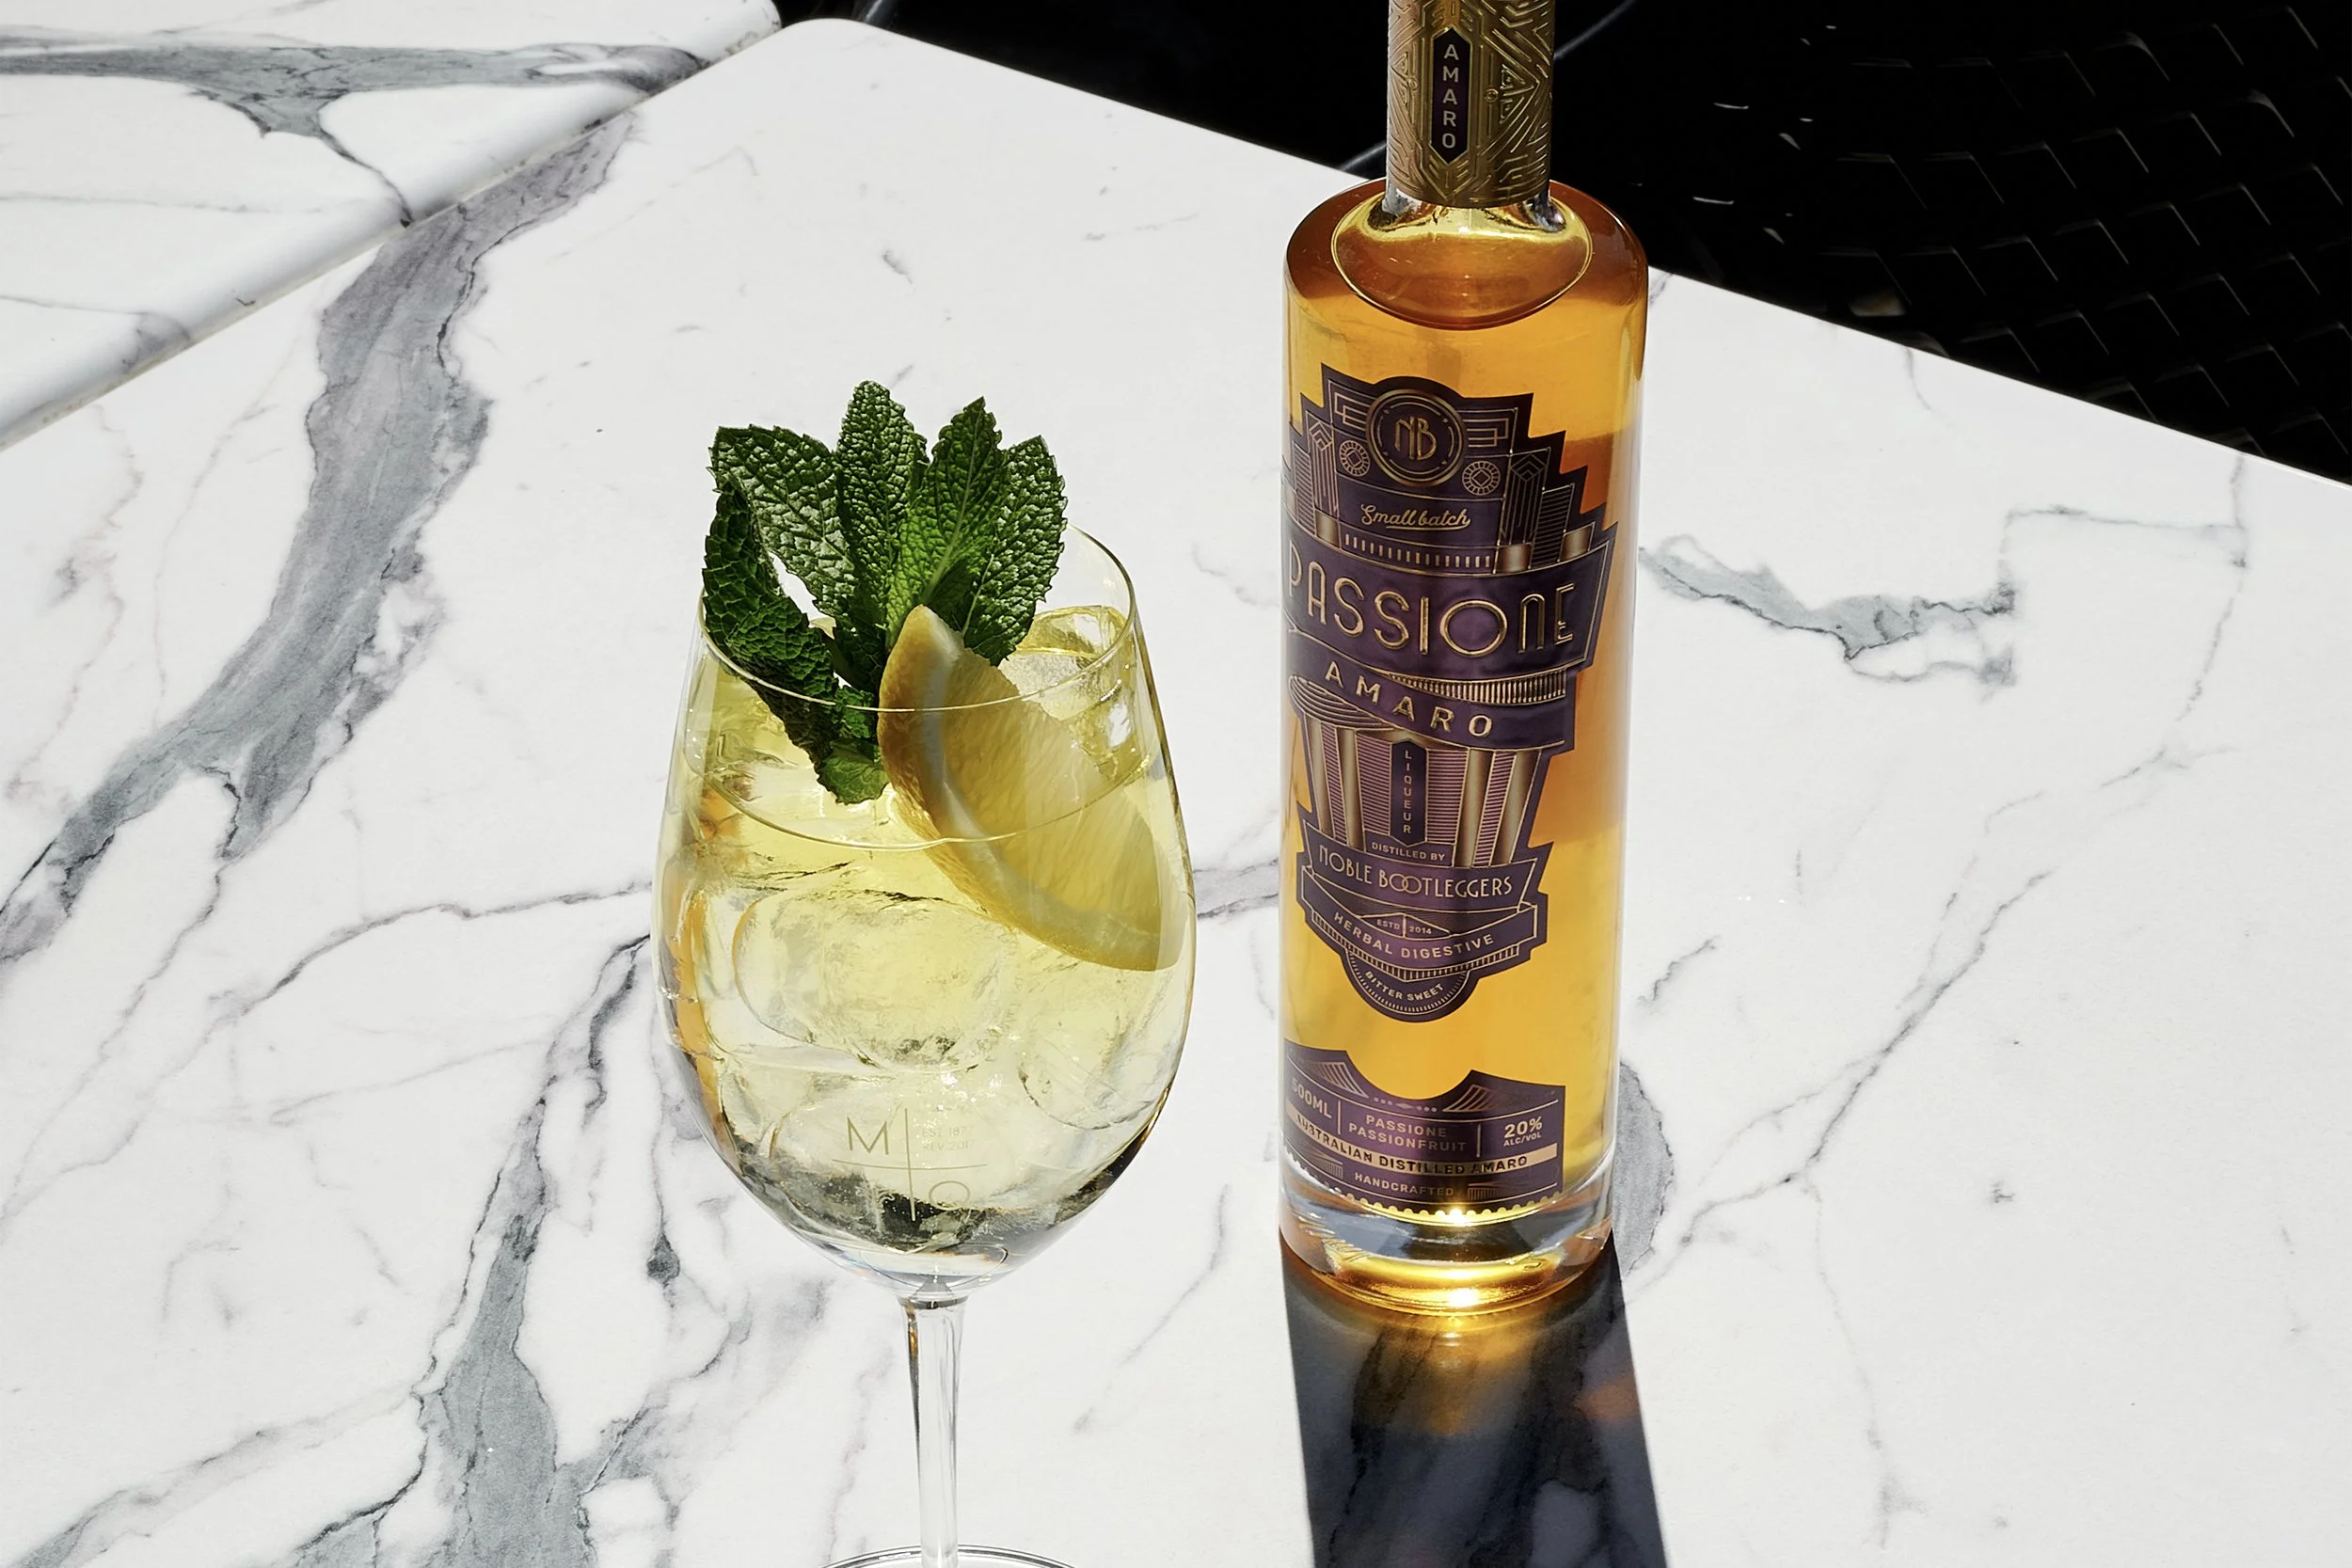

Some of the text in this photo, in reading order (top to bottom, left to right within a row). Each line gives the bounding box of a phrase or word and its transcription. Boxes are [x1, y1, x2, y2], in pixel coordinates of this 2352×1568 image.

[1442, 43, 1459, 150] AMARO
[1288, 539, 1575, 657] PASSIONE
[1324, 661, 1494, 737] AMARO
[1402, 750, 1412, 834] LIQUEUR
[1371, 841, 1446, 862] DISTILLED BY
[1319, 845, 1513, 898] NOBLE BOOTLEGGERS
[1333, 911, 1495, 959] HERBAL DIGESTIVE
[1376, 918, 1433, 935] ESTD 2014
[1365, 970, 1445, 1002] BITTER SWEET
[1292, 1077, 1333, 1119] 500ML
[1296, 1113, 1528, 1175] AUSTRALIAN DISTILLED AMARO
[1348, 1122, 1466, 1152] PASSIONFRUIT
[1366, 1115, 1448, 1138] PASSIONE
[1502, 1132, 1543, 1147] ALC/VOL
[1503, 1116, 1543, 1139] 20%
[1355, 1171, 1454, 1196] HANDCRAFTED
